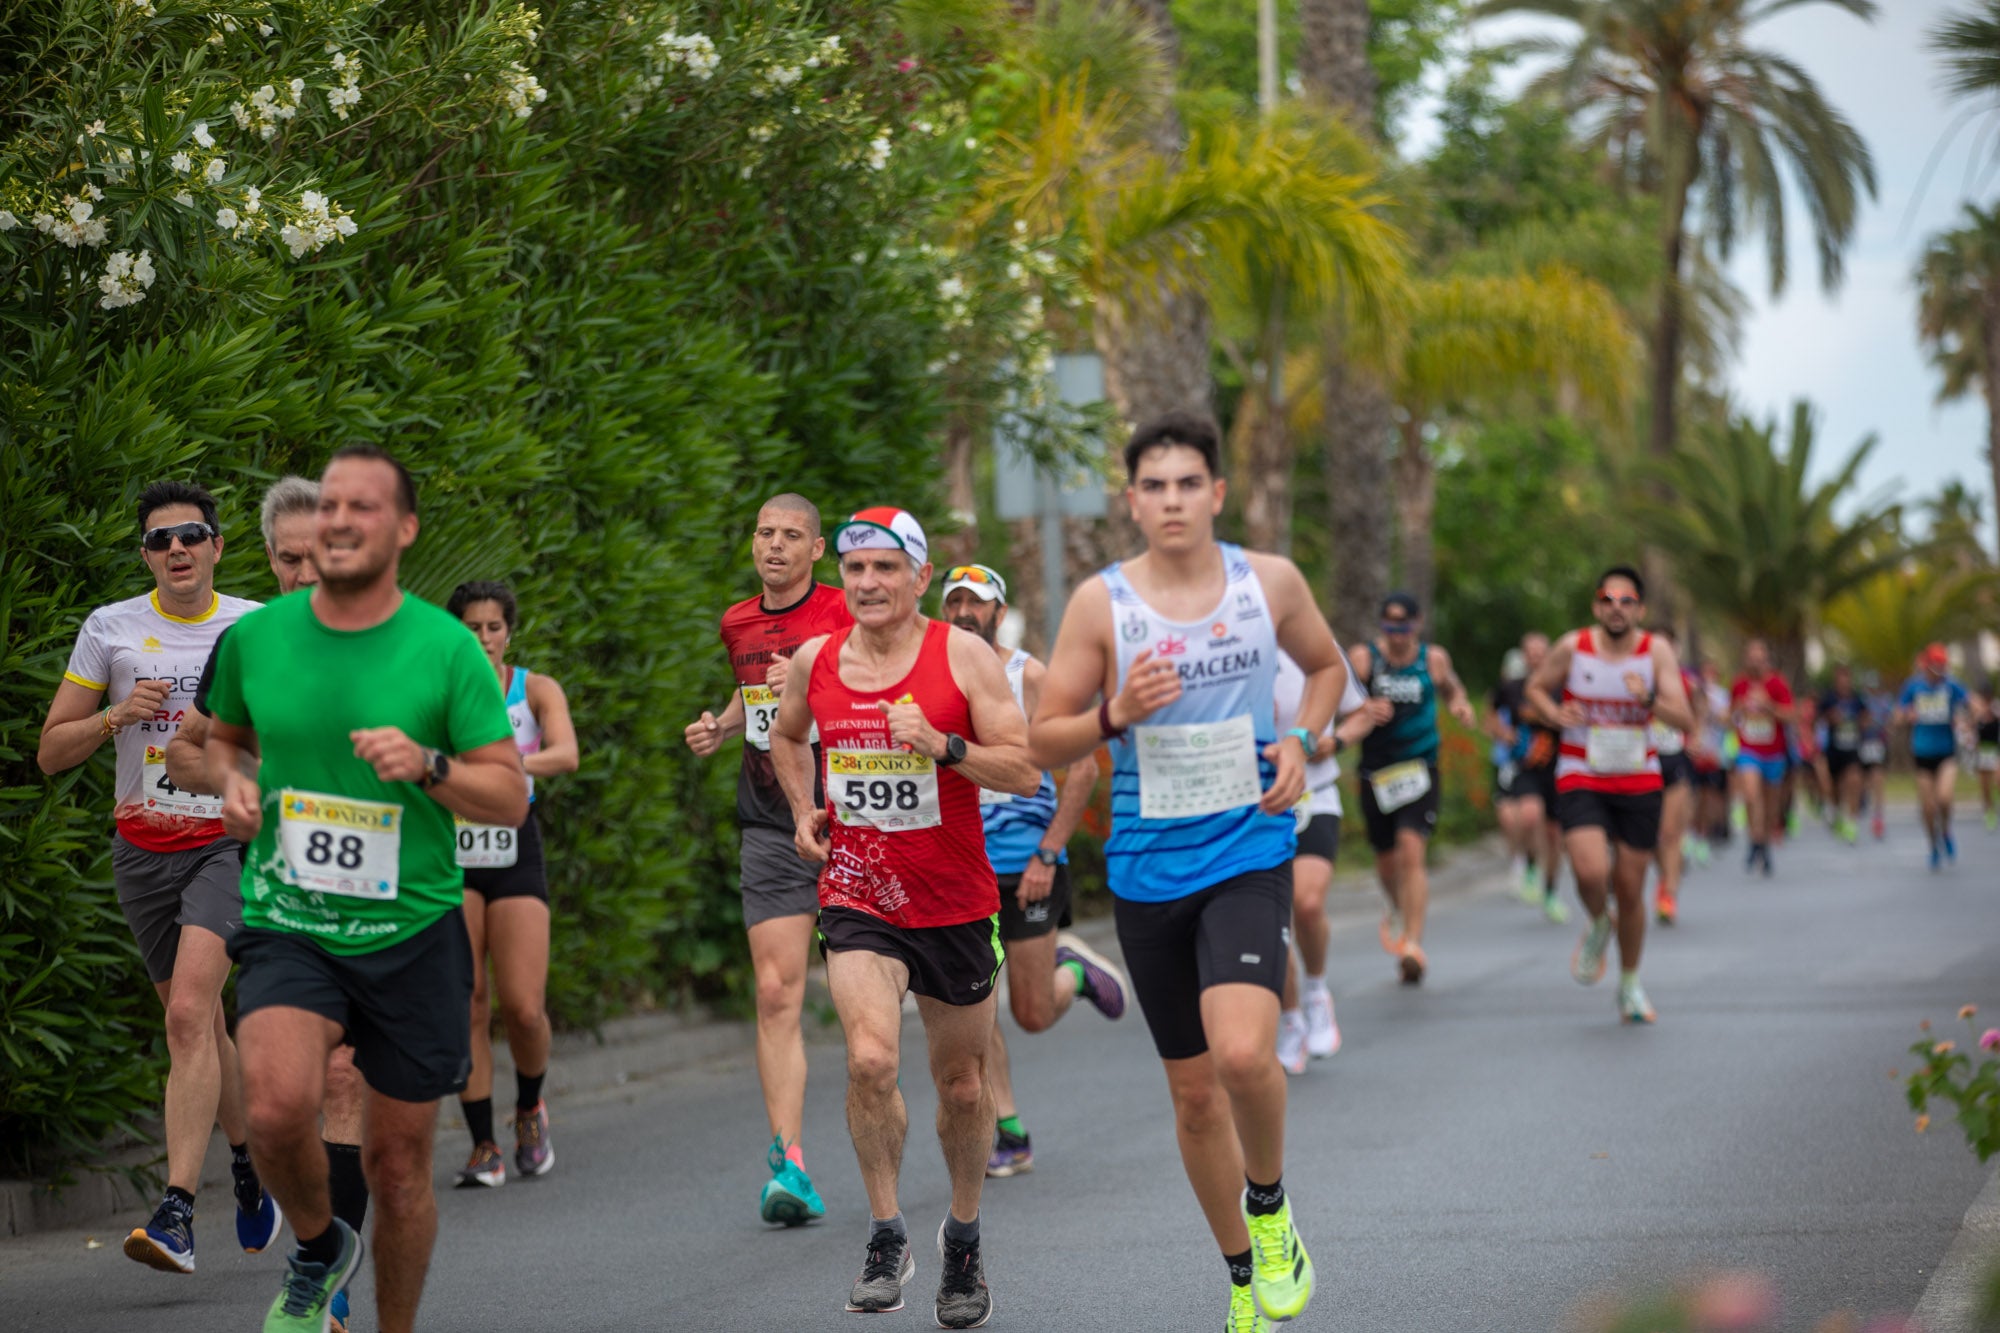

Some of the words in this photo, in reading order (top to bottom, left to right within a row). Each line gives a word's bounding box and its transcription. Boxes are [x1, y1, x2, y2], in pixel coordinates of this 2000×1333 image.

[1170, 648, 1261, 681] RACENA
[836, 719, 886, 729] GENERALI
[841, 754, 857, 769] 38
[844, 780, 919, 811] 598
[305, 830, 365, 871] 88
[456, 829, 512, 851] 019
